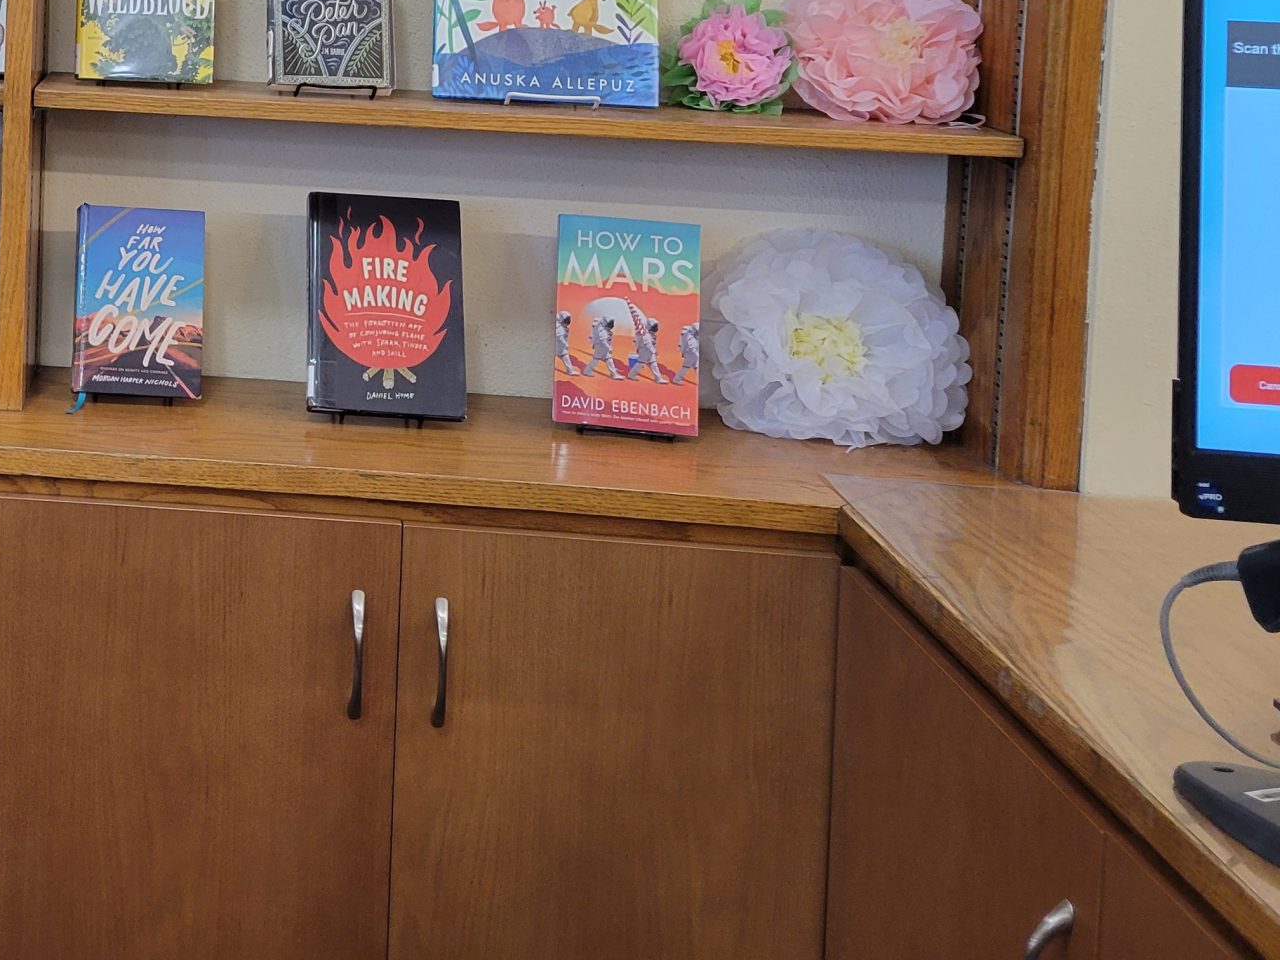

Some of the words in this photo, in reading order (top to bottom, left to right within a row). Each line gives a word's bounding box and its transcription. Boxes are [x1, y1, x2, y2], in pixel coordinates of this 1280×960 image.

[299, 20, 368, 60] Pan
[1232, 42, 1268, 55] Scan
[461, 72, 541, 87] ANUSKA
[552, 76, 635, 92] ALLEPUZ
[127, 236, 163, 252] FAR
[577, 229, 642, 252] HOW
[650, 235, 683, 255] TO
[118, 246, 174, 274] YOU
[362, 256, 410, 282] FIRE
[563, 250, 696, 296] MARS
[95, 270, 185, 313] HAVE
[343, 284, 428, 316] MAKING
[88, 304, 186, 368] COME
[360, 329, 399, 337] CONJURING
[402, 330, 426, 341] FLAME
[364, 319, 406, 328] FORGOTTEN
[407, 323, 423, 332] ART
[352, 341, 372, 350] WITH
[387, 350, 407, 358] SKILL
[92, 374, 119, 383] MORGAN
[120, 376, 144, 384] HARPER
[144, 378, 178, 388] NICHOLS
[366, 392, 393, 401] DANIEL
[562, 394, 605, 410] DAVID
[612, 399, 691, 420] EBENBACH
